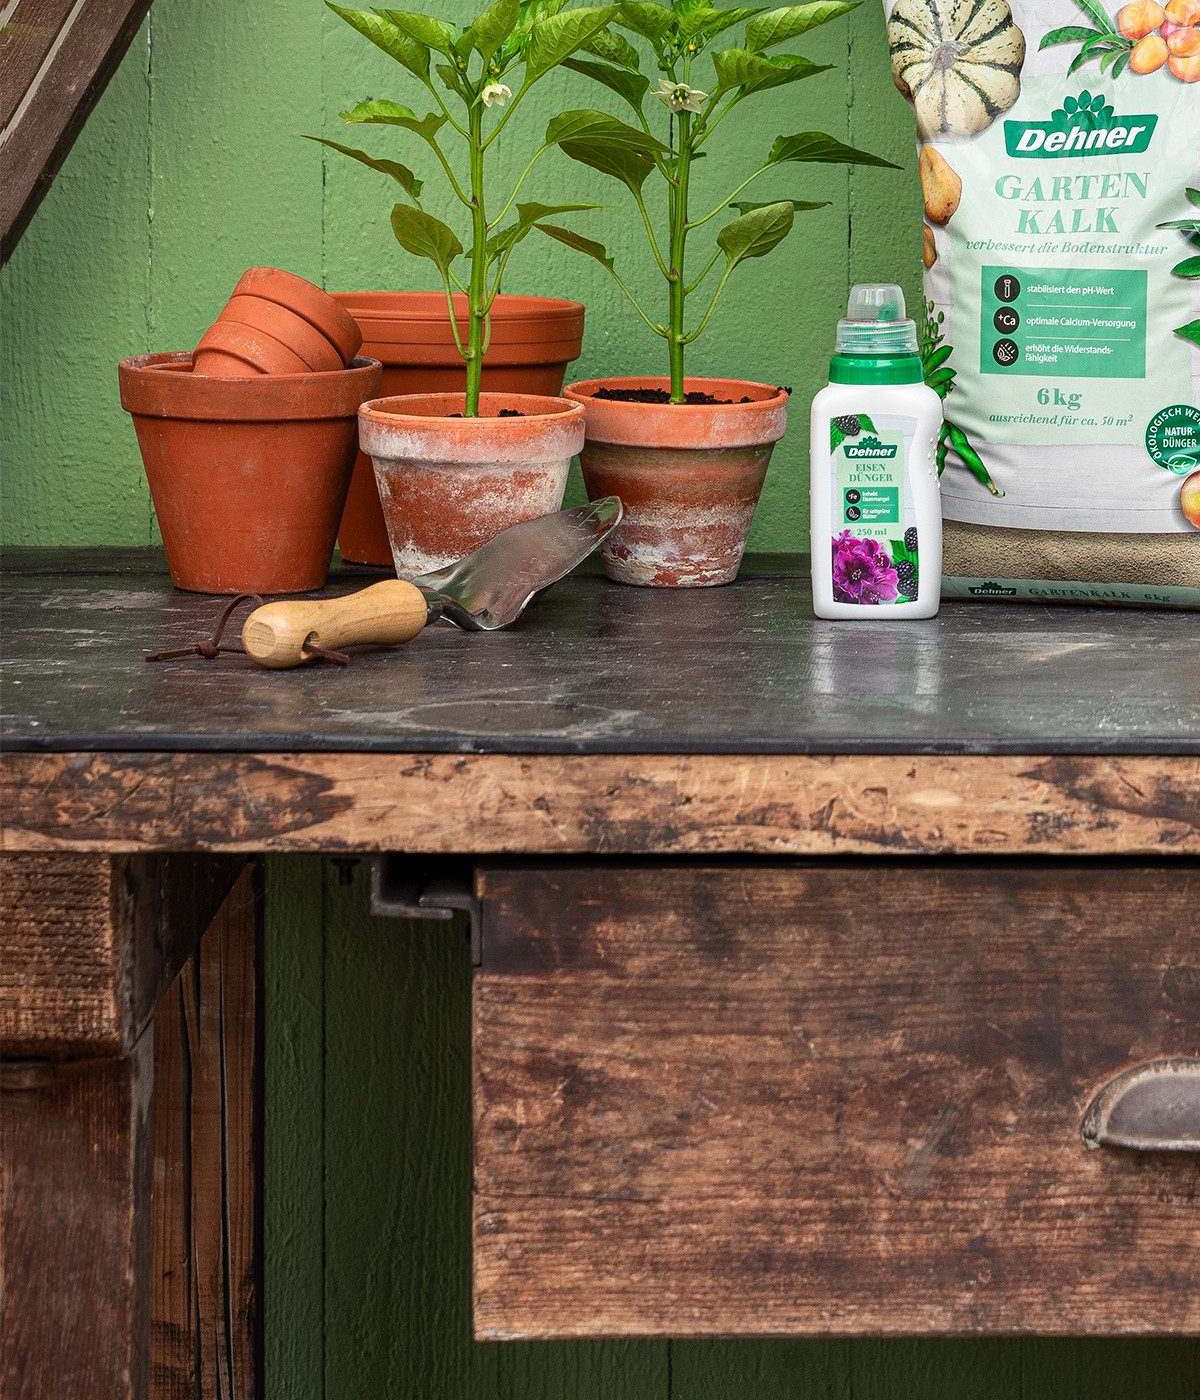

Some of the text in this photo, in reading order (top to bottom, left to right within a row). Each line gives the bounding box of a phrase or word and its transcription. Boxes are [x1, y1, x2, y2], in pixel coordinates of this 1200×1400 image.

[1016, 125, 1146, 152] Dehner
[995, 172, 1151, 202] GARTEN
[1014, 206, 1120, 235] KALK
[966, 239, 1168, 256] verbessert die Bodenstruktur
[1027, 285, 1114, 296] stabilisiert den pH-Wert
[1026, 317, 1136, 329] optimale Calcium-Versorgung
[1026, 344, 1114, 355] erhöht die Widerstands-
[1025, 353, 1058, 363] fähigkeit
[1037, 387, 1083, 411] 6 kg
[989, 413, 1057, 425] ausreichend
[1056, 414, 1079, 427] für
[1081, 417, 1098, 426] ca.
[1101, 415, 1114, 426] 50
[1148, 408, 1182, 460] ÖKOLOGISCH
[1165, 427, 1196, 436] NATUR-
[1163, 437, 1197, 448] DÜNGER
[849, 447, 894, 457] Dehner
[856, 463, 886, 472] EISEN
[849, 472, 893, 482] DÜNGER
[858, 528, 887, 536] 250 ml
[1029, 588, 1131, 599] GARTENKALK
[1152, 594, 1171, 602] kg
